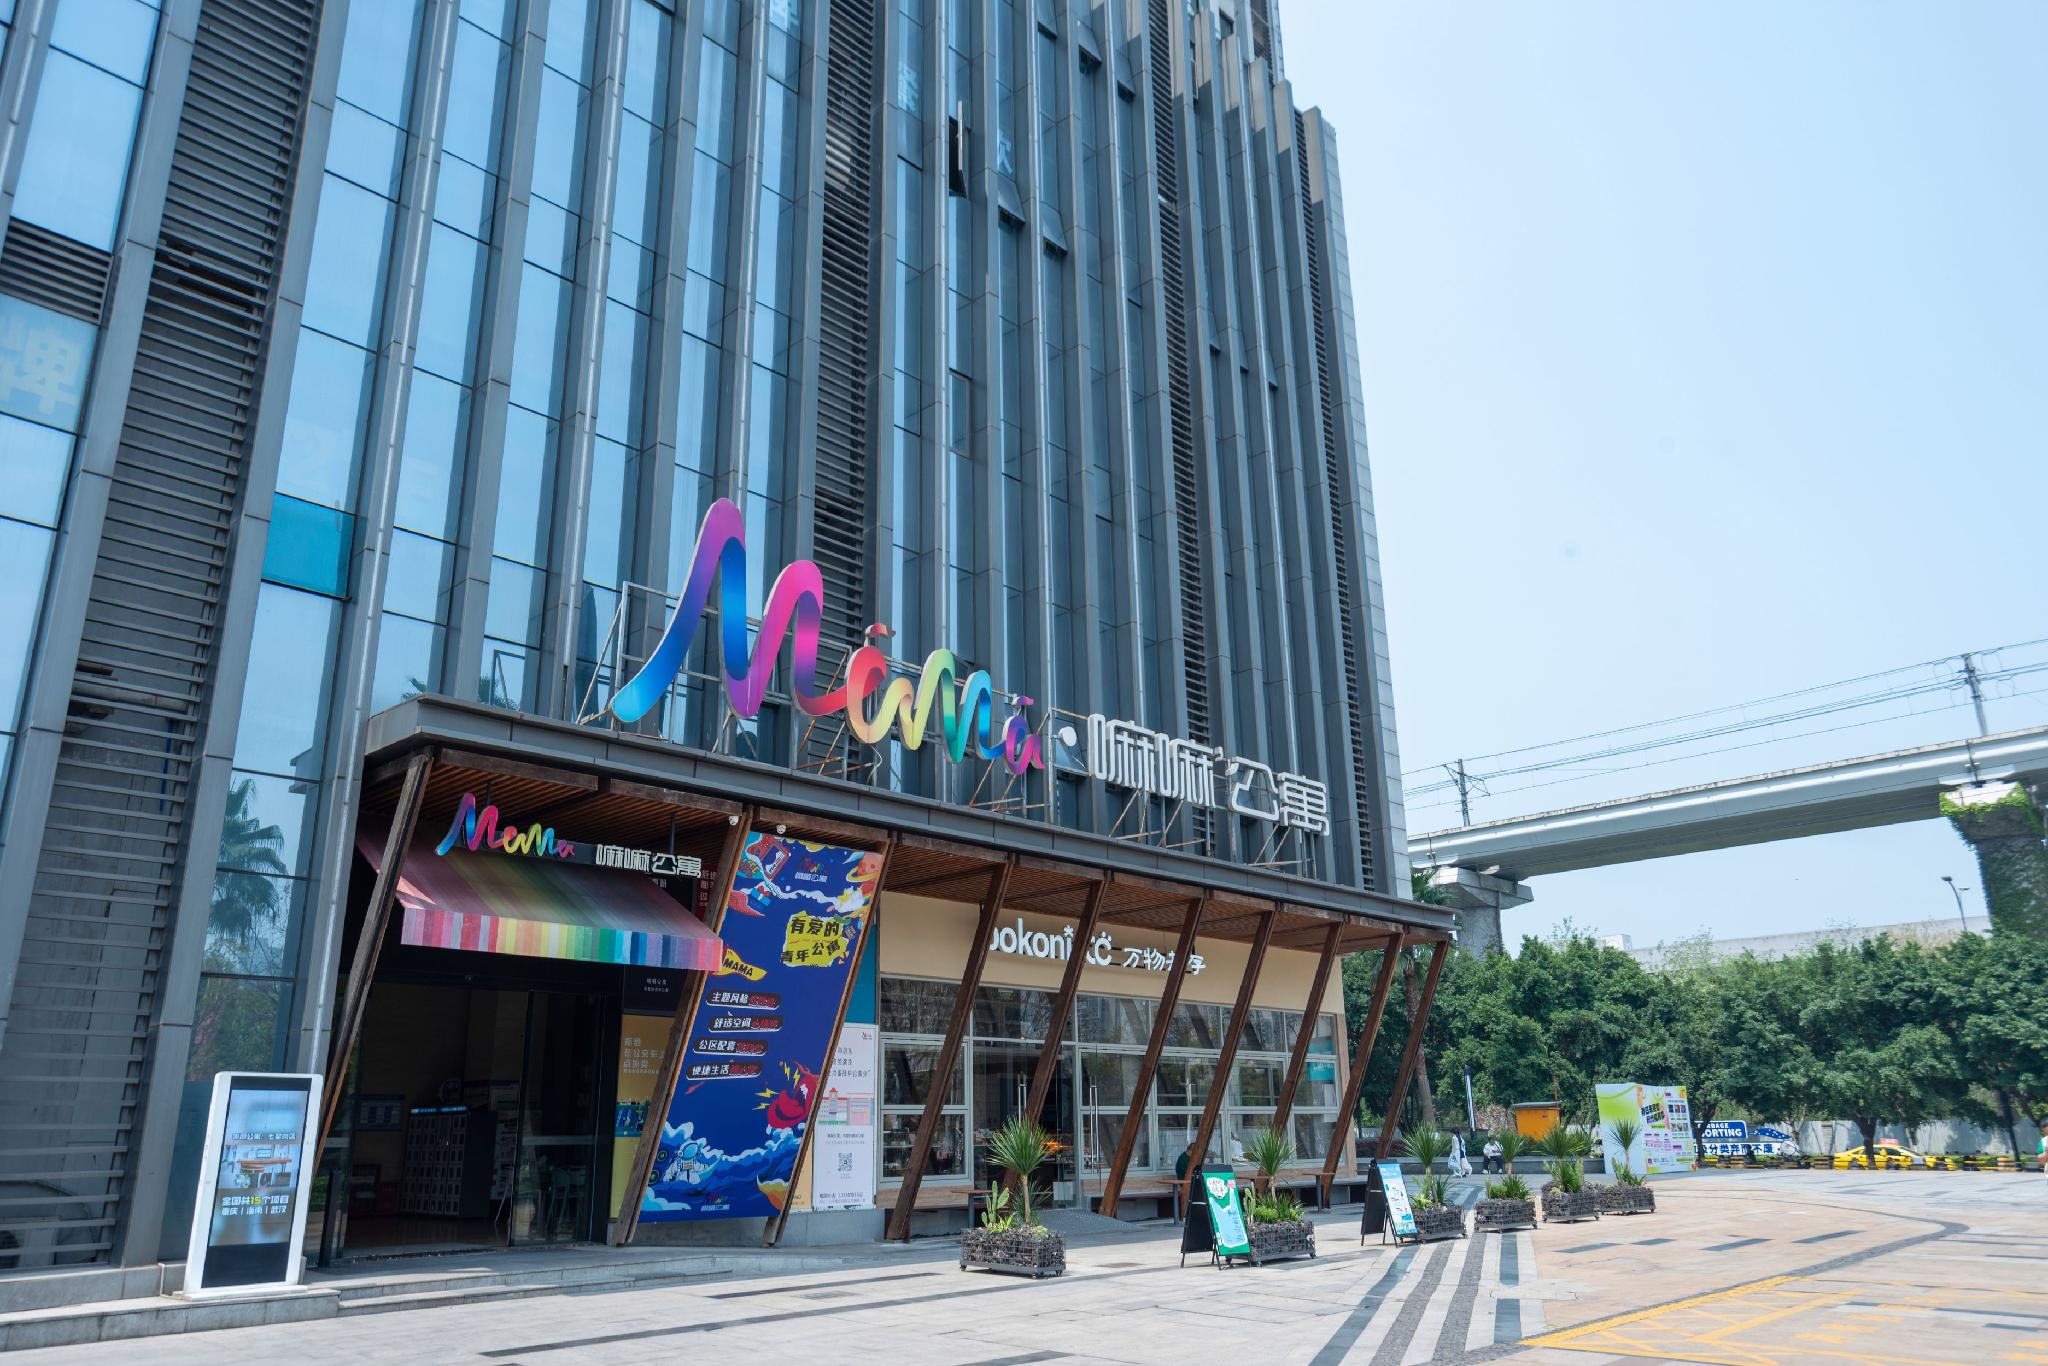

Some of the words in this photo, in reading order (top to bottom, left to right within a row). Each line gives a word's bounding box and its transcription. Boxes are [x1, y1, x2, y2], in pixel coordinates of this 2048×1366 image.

[1087, 712, 1330, 836] 嘛嘛公寓
[596, 843, 702, 878] 嘛嘛公寓
[790, 916, 840, 936] 有爱的
[780, 939, 840, 964] 青年公寓
[722, 957, 753, 976] MAMA
[711, 992, 749, 1004] 主题风格
[713, 1017, 752, 1028] 舒适空间
[699, 1040, 737, 1051] 公区配套
[692, 1065, 730, 1076] 便捷生活
[1702, 1129, 1742, 1137] ORTING
[222, 1195, 289, 1205] 全国共15个项目
